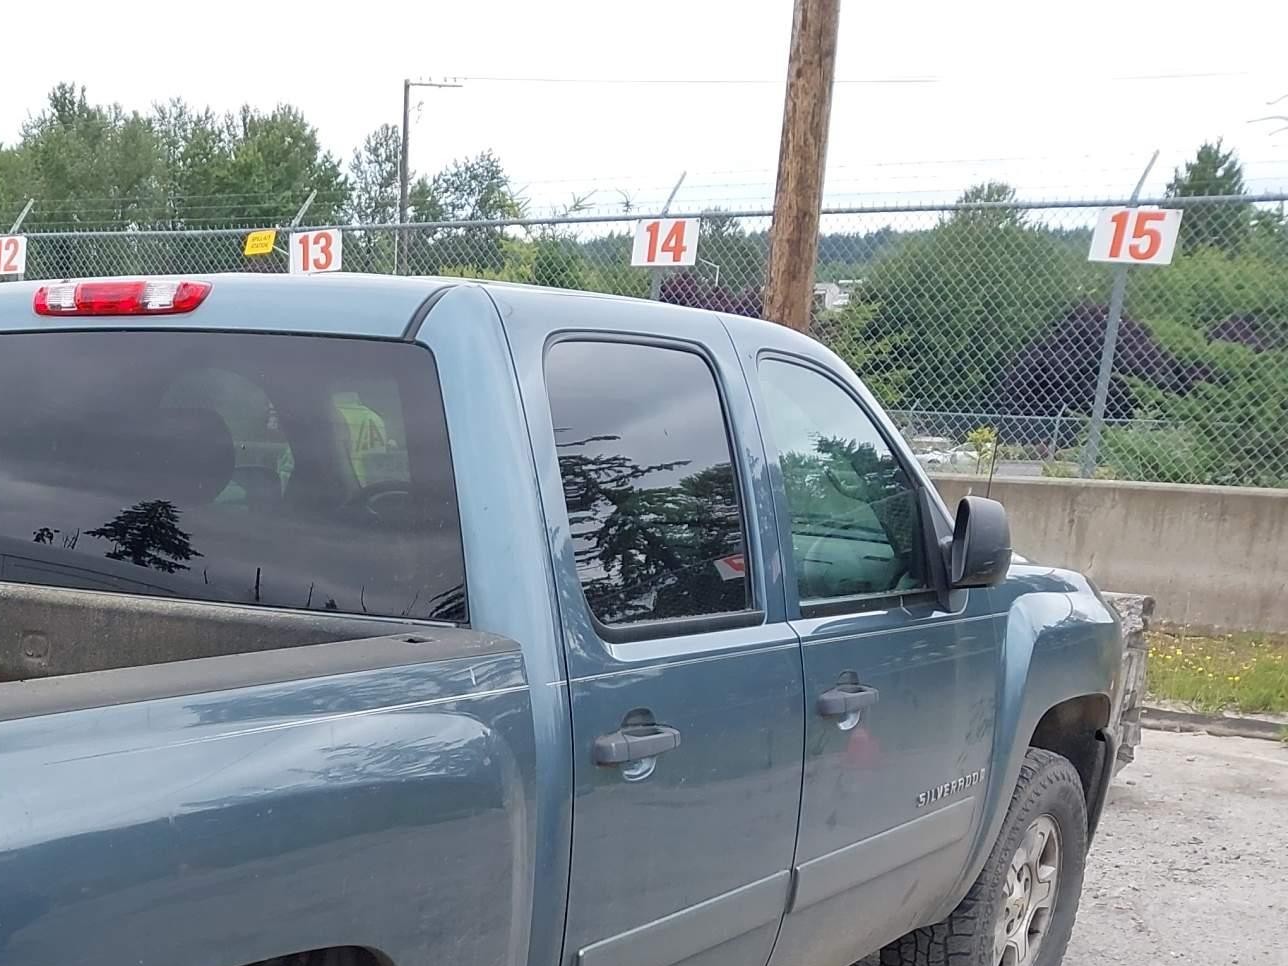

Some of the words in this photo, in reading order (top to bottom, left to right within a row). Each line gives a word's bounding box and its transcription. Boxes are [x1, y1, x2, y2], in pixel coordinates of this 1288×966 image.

[298, 231, 334, 272] 13
[645, 220, 688, 263] 14
[1108, 210, 1167, 261] 15
[917, 767, 986, 808] SILVERADO
